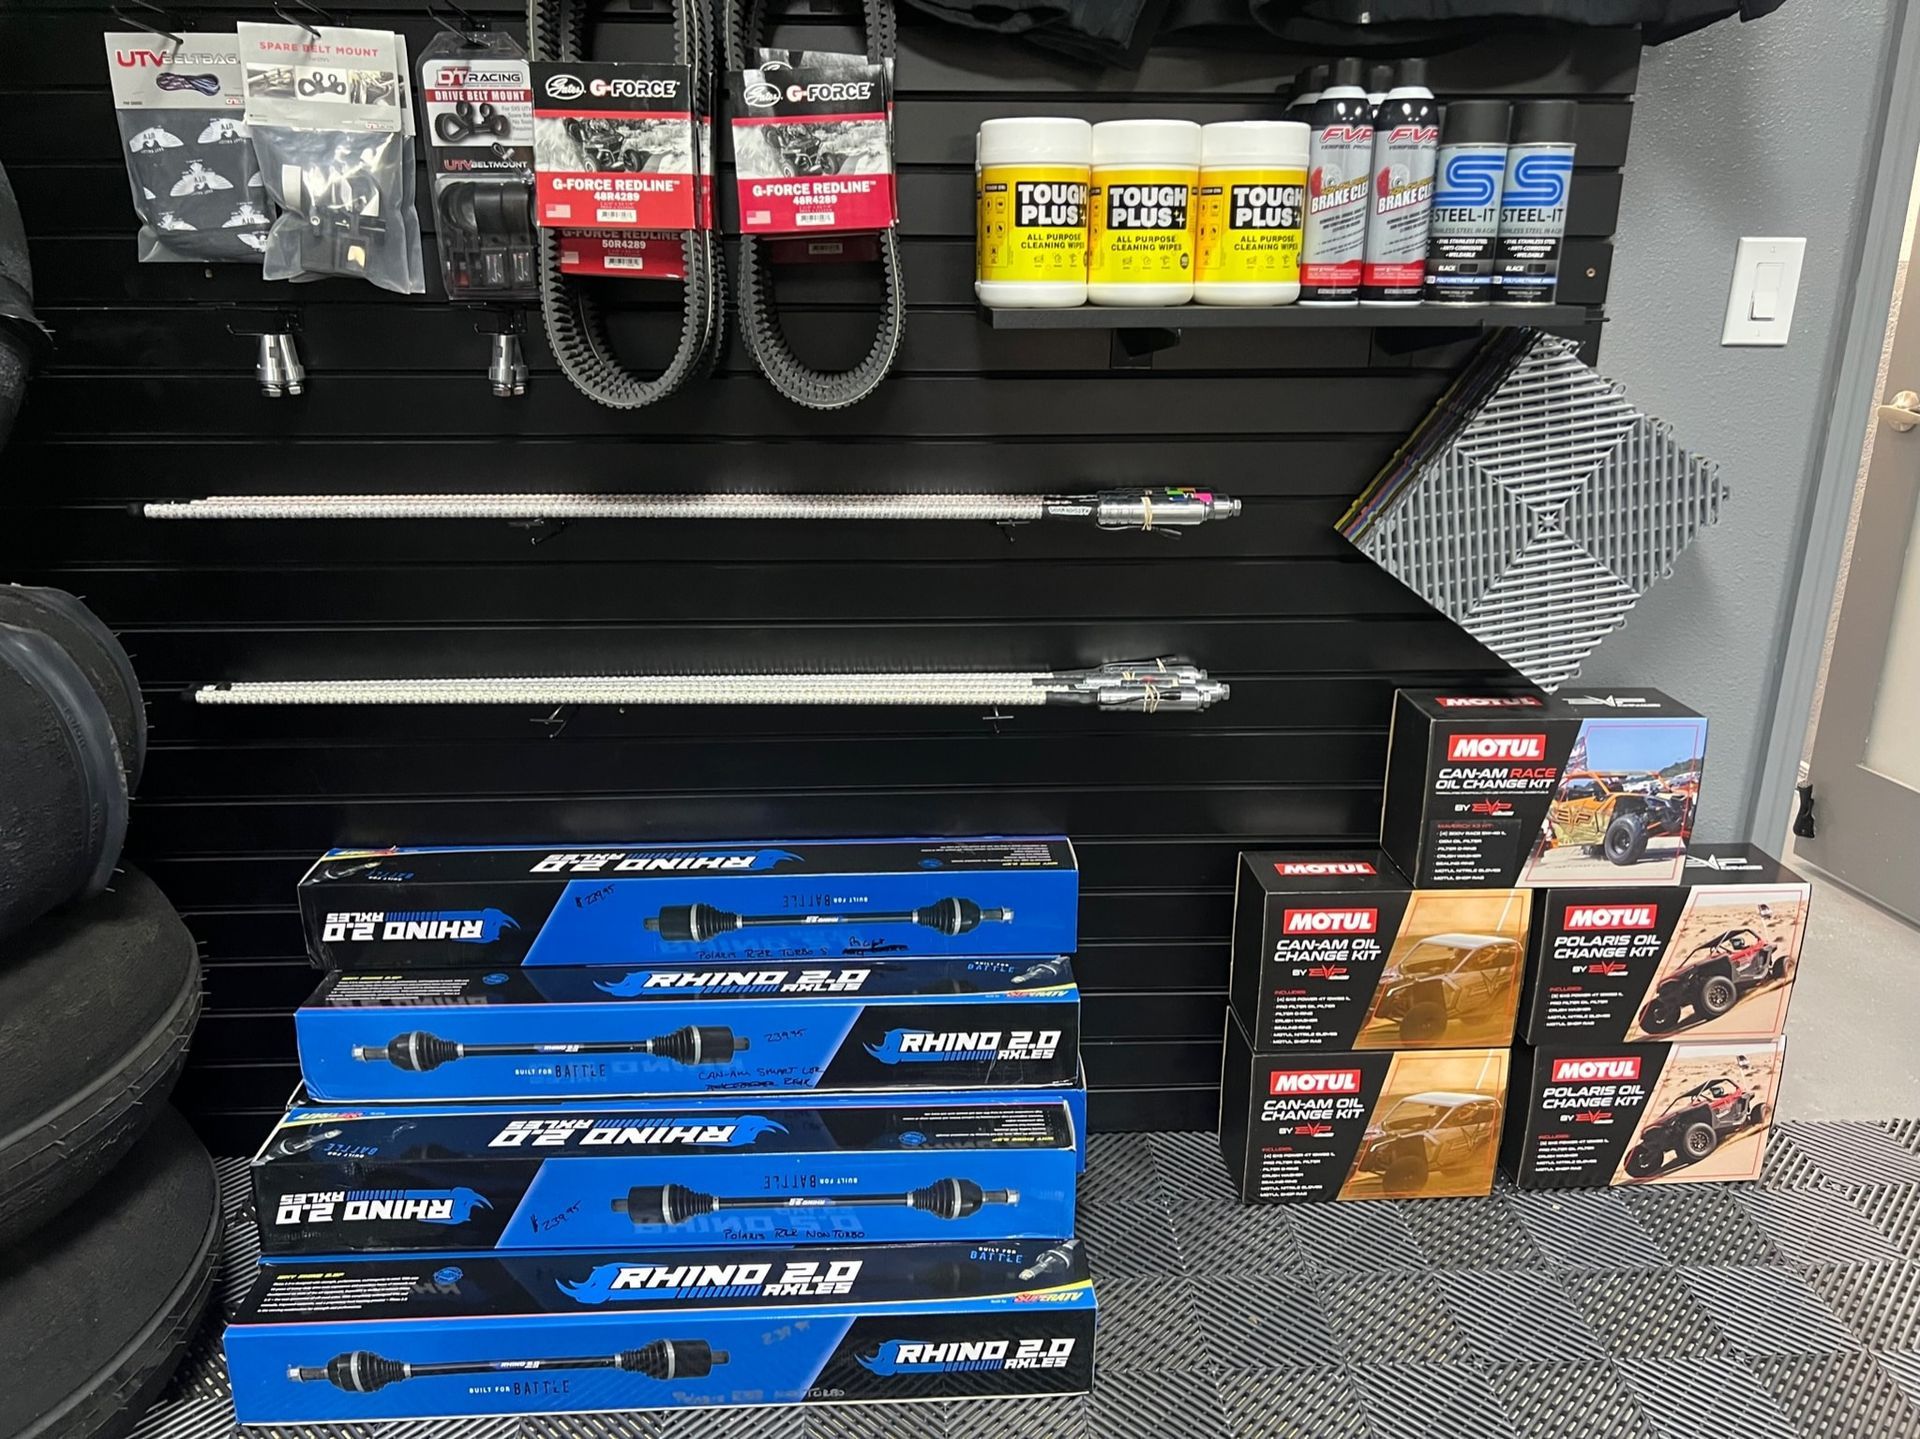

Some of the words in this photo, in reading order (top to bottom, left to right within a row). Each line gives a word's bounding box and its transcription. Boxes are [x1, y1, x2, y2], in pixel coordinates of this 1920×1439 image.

[260, 42, 298, 52] SPARE
[302, 44, 331, 54] BELT
[336, 47, 379, 57] MOUNT
[469, 73, 521, 82] RACING
[434, 90, 465, 101] DRIVE
[466, 90, 489, 101] BELT
[491, 90, 525, 101] MOUNT
[1320, 124, 1373, 144] FVP
[552, 178, 612, 190] G-FORCE
[752, 182, 811, 197] G-FORCE
[594, 192, 640, 202] 48R4289
[1018, 184, 1087, 205] TOUGH
[1109, 186, 1187, 207] TOUGH
[1233, 186, 1303, 207] TOUGH
[1311, 189, 1350, 214] BRAKE
[1377, 189, 1416, 214] BRAKE
[1021, 205, 1079, 225] PLUS
[1112, 207, 1173, 228] PLUS
[1235, 207, 1293, 227] PLUS
[1435, 208, 1496, 222] STEEL-IT
[1501, 208, 1564, 222] STEEL-IT
[1046, 233, 1081, 241] PURPOSE
[602, 240, 646, 249] 50R4289
[1020, 241, 1066, 249] CLEANING
[1234, 243, 1279, 251] CLEANING
[1446, 698, 1536, 706] MOTUL
[1452, 738, 1540, 758] MOTUL
[1438, 767, 1508, 779] CAN-AM
[1510, 767, 1557, 778] RACE
[1435, 779, 1461, 789] OIL
[1462, 779, 1527, 789] CHANGE
[1528, 779, 1555, 788] KIT
[1454, 804, 1471, 812] BY
[548, 853, 625, 863] AXLES
[613, 855, 757, 872] RHINO
[529, 859, 610, 873] 2.0
[1283, 863, 1369, 873] MOTUL
[326, 911, 385, 923] AXLES
[1287, 912, 1372, 931] MOTUL
[1568, 908, 1651, 928] MOTUL
[322, 922, 376, 942] 2.0
[382, 920, 484, 941] RHINO
[1276, 939, 1349, 951] CAN-AM
[1351, 938, 1380, 949] OIL
[1554, 935, 1631, 947] POLARIS
[1633, 934, 1662, 945] OIL
[1273, 950, 1349, 961] CHANGE
[1351, 950, 1382, 960] KIT
[1553, 947, 1628, 959] CHANGE
[1629, 946, 1659, 957] KIT
[1292, 968, 1307, 976] BY
[1572, 965, 1587, 973] BY
[643, 971, 789, 988] RHINO
[799, 969, 871, 984] 2.0
[780, 982, 862, 993] AXLES
[901, 1031, 1002, 1051] RHINO
[1007, 1030, 1062, 1050] 2.0
[997, 1048, 1056, 1061] AXLES
[554, 1064, 606, 1078] BATTLE
[1557, 1061, 1637, 1079] MOTUL
[1275, 1073, 1356, 1091] MOTUL
[1543, 1085, 1617, 1098] POLARIS
[1618, 1085, 1645, 1095] OIL
[1263, 1099, 1333, 1111] CAN-AM
[1336, 1098, 1364, 1109] OIL
[1542, 1096, 1614, 1109] CHANGE
[1614, 1096, 1643, 1106] KIT
[1261, 1110, 1334, 1121] CHANGE
[1336, 1109, 1365, 1119] KIT
[1560, 1114, 1575, 1122] BY
[505, 1118, 595, 1131] AXLES
[1279, 1127, 1293, 1135] BY
[488, 1129, 577, 1147] 2.0
[578, 1124, 736, 1146] RHINO
[763, 1175, 817, 1190] BATTLE
[279, 1191, 345, 1205] AXLES
[275, 1204, 334, 1226] 2.0
[342, 1199, 455, 1221] RHINO
[970, 1250, 1024, 1264] BATTLE
[610, 1263, 772, 1290] RHINO
[782, 1259, 864, 1284] 2.0
[762, 1281, 854, 1297] AXLES
[895, 1340, 1010, 1365] RHINO
[1015, 1337, 1077, 1360] 2.0
[1004, 1356, 1068, 1370] AXLES
[513, 1380, 571, 1397] BATTLE
